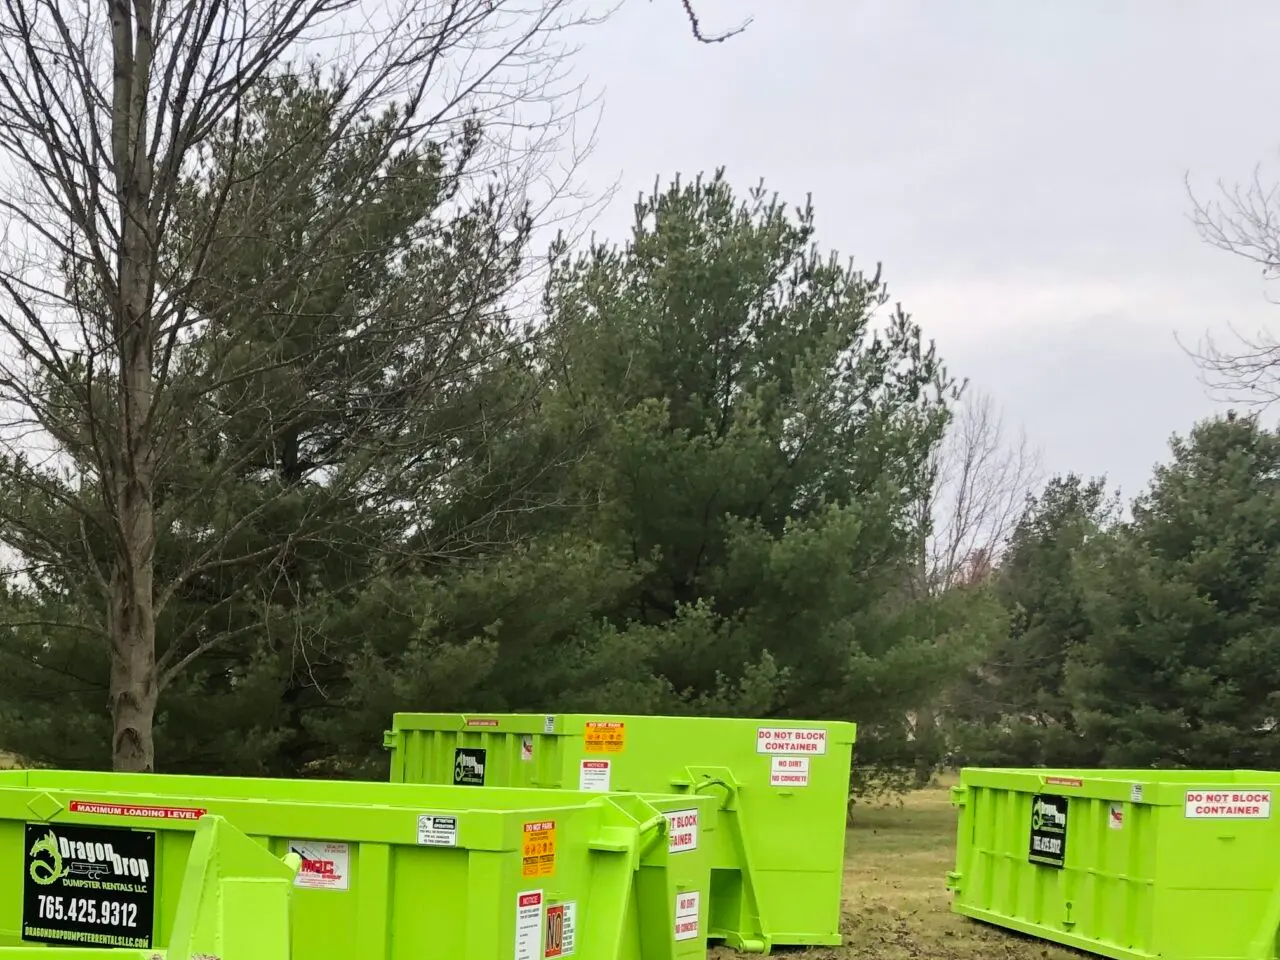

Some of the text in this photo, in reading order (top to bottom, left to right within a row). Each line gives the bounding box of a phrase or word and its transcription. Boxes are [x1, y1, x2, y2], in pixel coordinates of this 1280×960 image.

[759, 731, 824, 740] DO NOT BLOCK
[765, 743, 817, 751] CONTAINER
[1187, 794, 1269, 802] DO NOT BLOCK
[77, 804, 198, 819] MAXIMUM LOADING LEVEL
[1196, 806, 1260, 814] CONTAINER
[62, 878, 148, 893] DUMPSTER RENTALS LLC
[38, 895, 138, 928] 765.425.9312
[546, 912, 562, 952] NO
